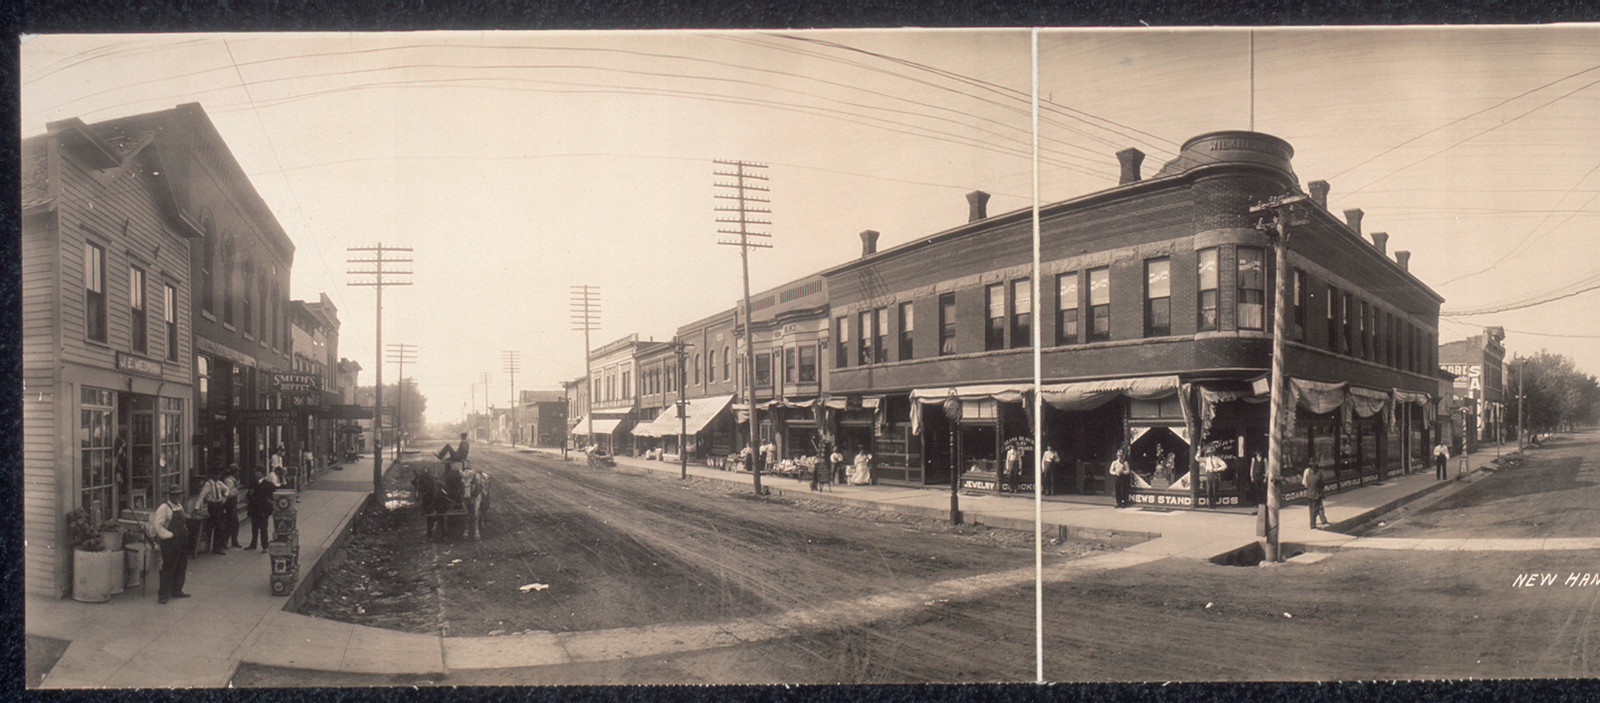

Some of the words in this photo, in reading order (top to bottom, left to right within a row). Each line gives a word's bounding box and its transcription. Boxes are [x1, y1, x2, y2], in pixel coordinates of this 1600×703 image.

[964, 480, 995, 490] JEWELRY
[1128, 494, 1155, 504] NEWS
[1157, 495, 1191, 506] STAND
